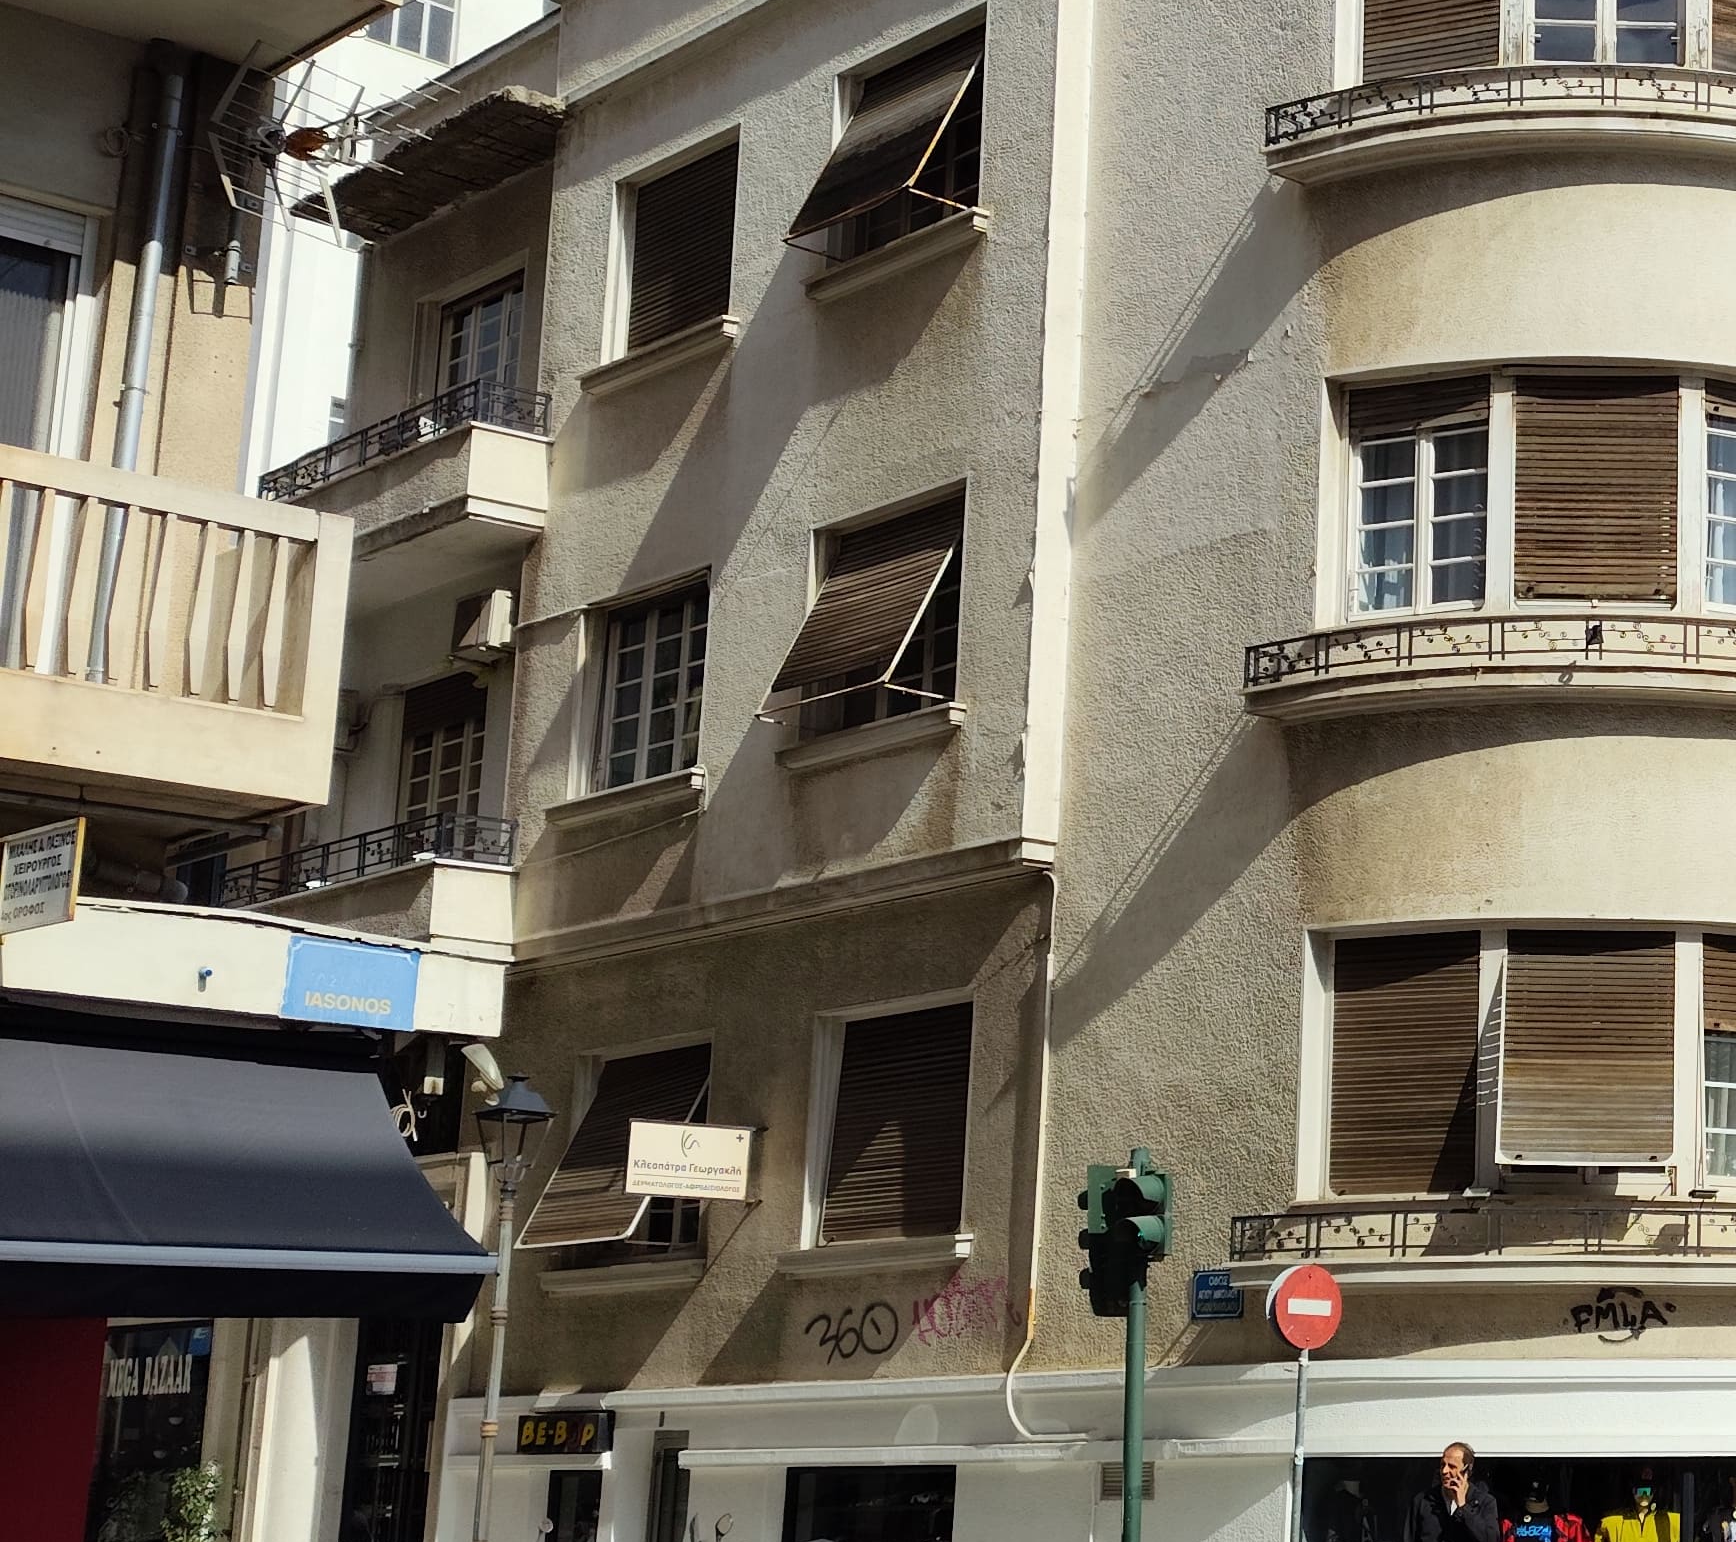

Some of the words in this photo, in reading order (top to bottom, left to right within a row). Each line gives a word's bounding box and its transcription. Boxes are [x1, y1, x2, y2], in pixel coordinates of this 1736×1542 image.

[13, 854, 62, 876] ΧΕΙΡΟΥΡΓΟΣ
[304, 990, 392, 1015] IASONOS
[633, 1159, 687, 1172] Κλεοπάτρα
[107, 1358, 139, 1398] MEGA
[143, 1354, 192, 1395] BAZAAR
